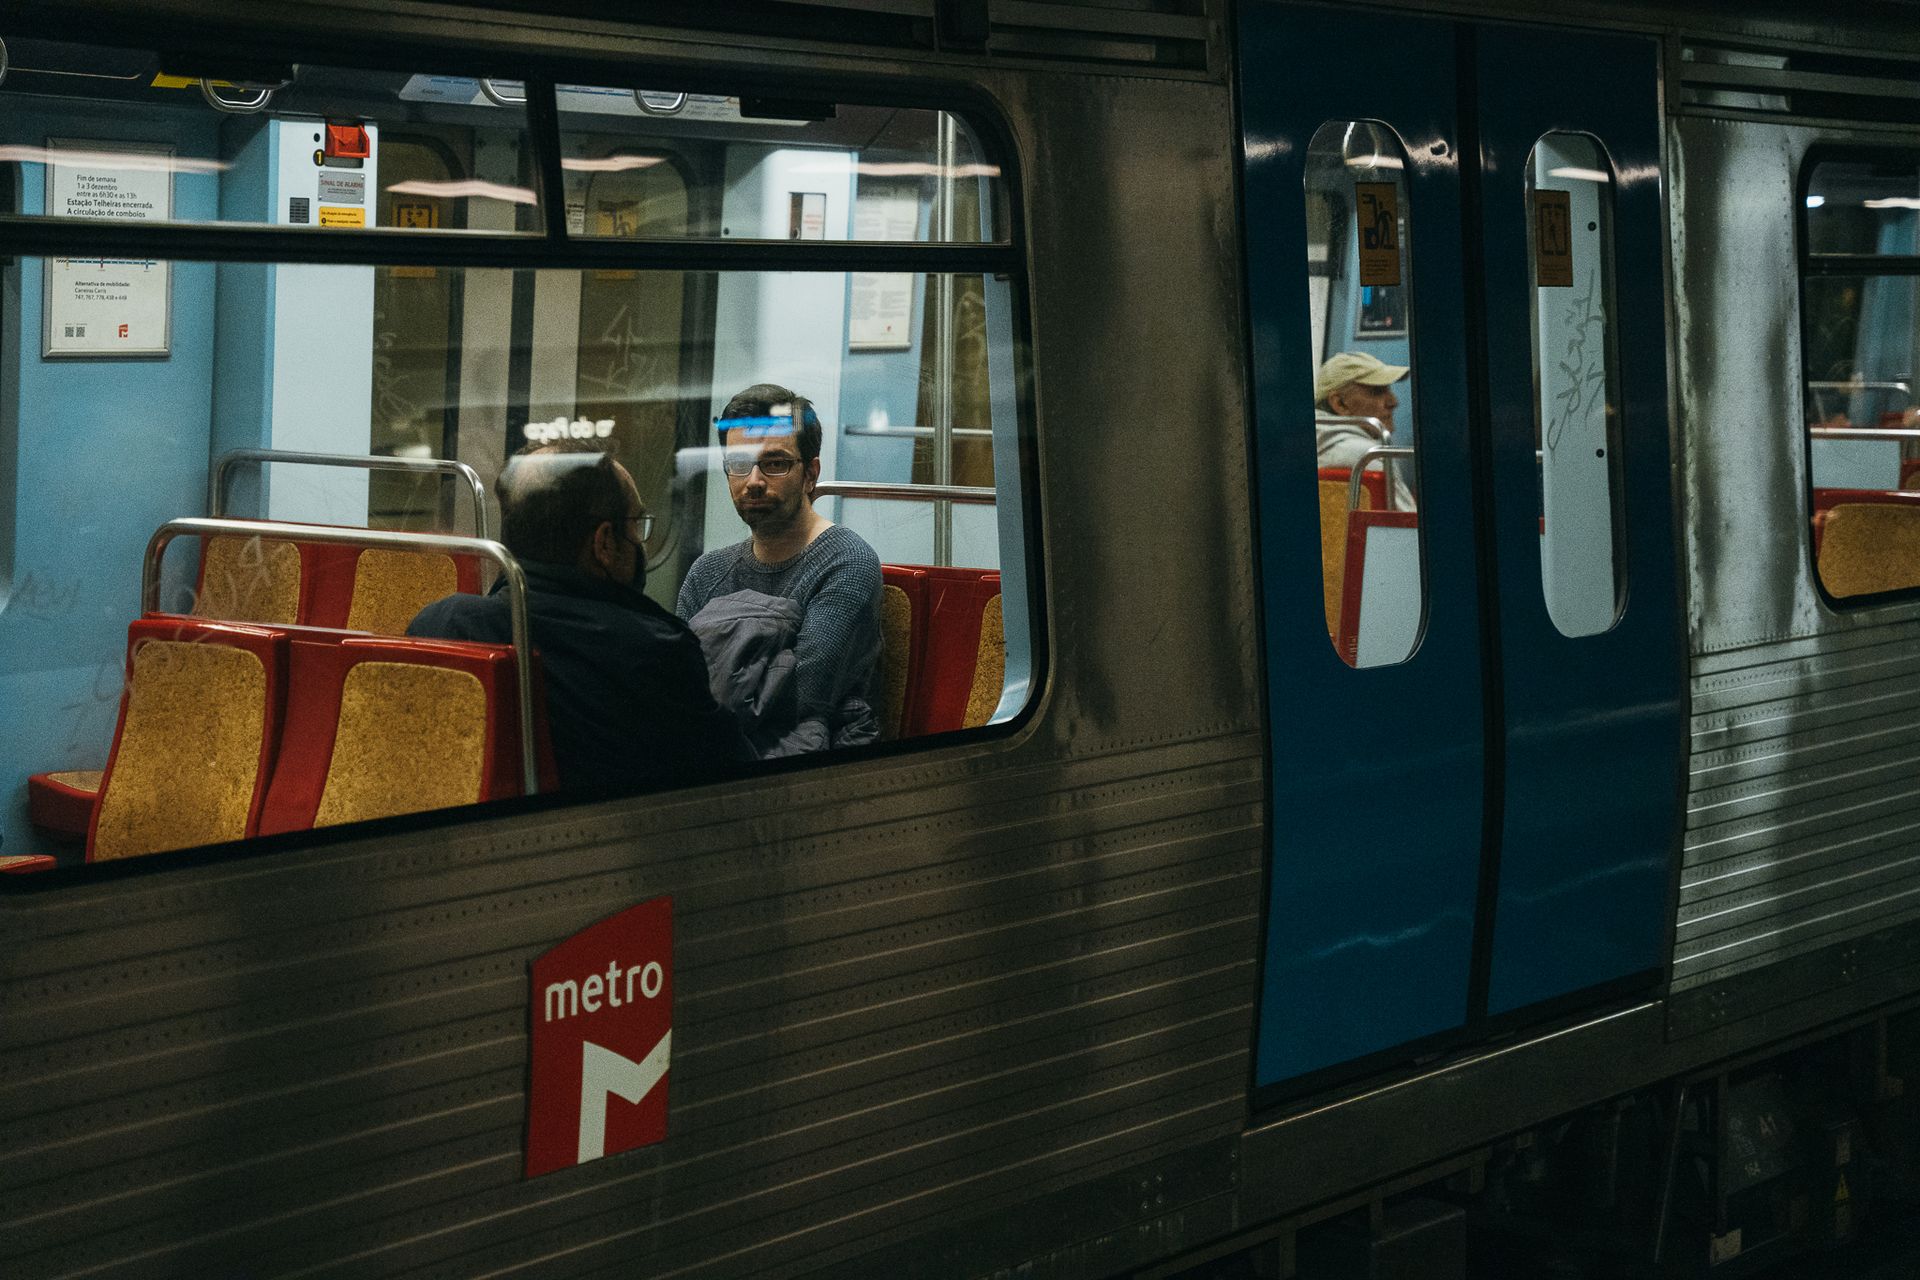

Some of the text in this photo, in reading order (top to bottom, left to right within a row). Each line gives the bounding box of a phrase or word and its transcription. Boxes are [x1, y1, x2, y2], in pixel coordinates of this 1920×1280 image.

[316, 151, 322, 164] 1
[67, 198, 92, 207] Estação
[94, 200, 121, 208] Telheiras
[74, 208, 106, 217] circulação
[107, 209, 115, 217] de
[116, 210, 146, 218] comboios
[545, 960, 663, 1022] metro
